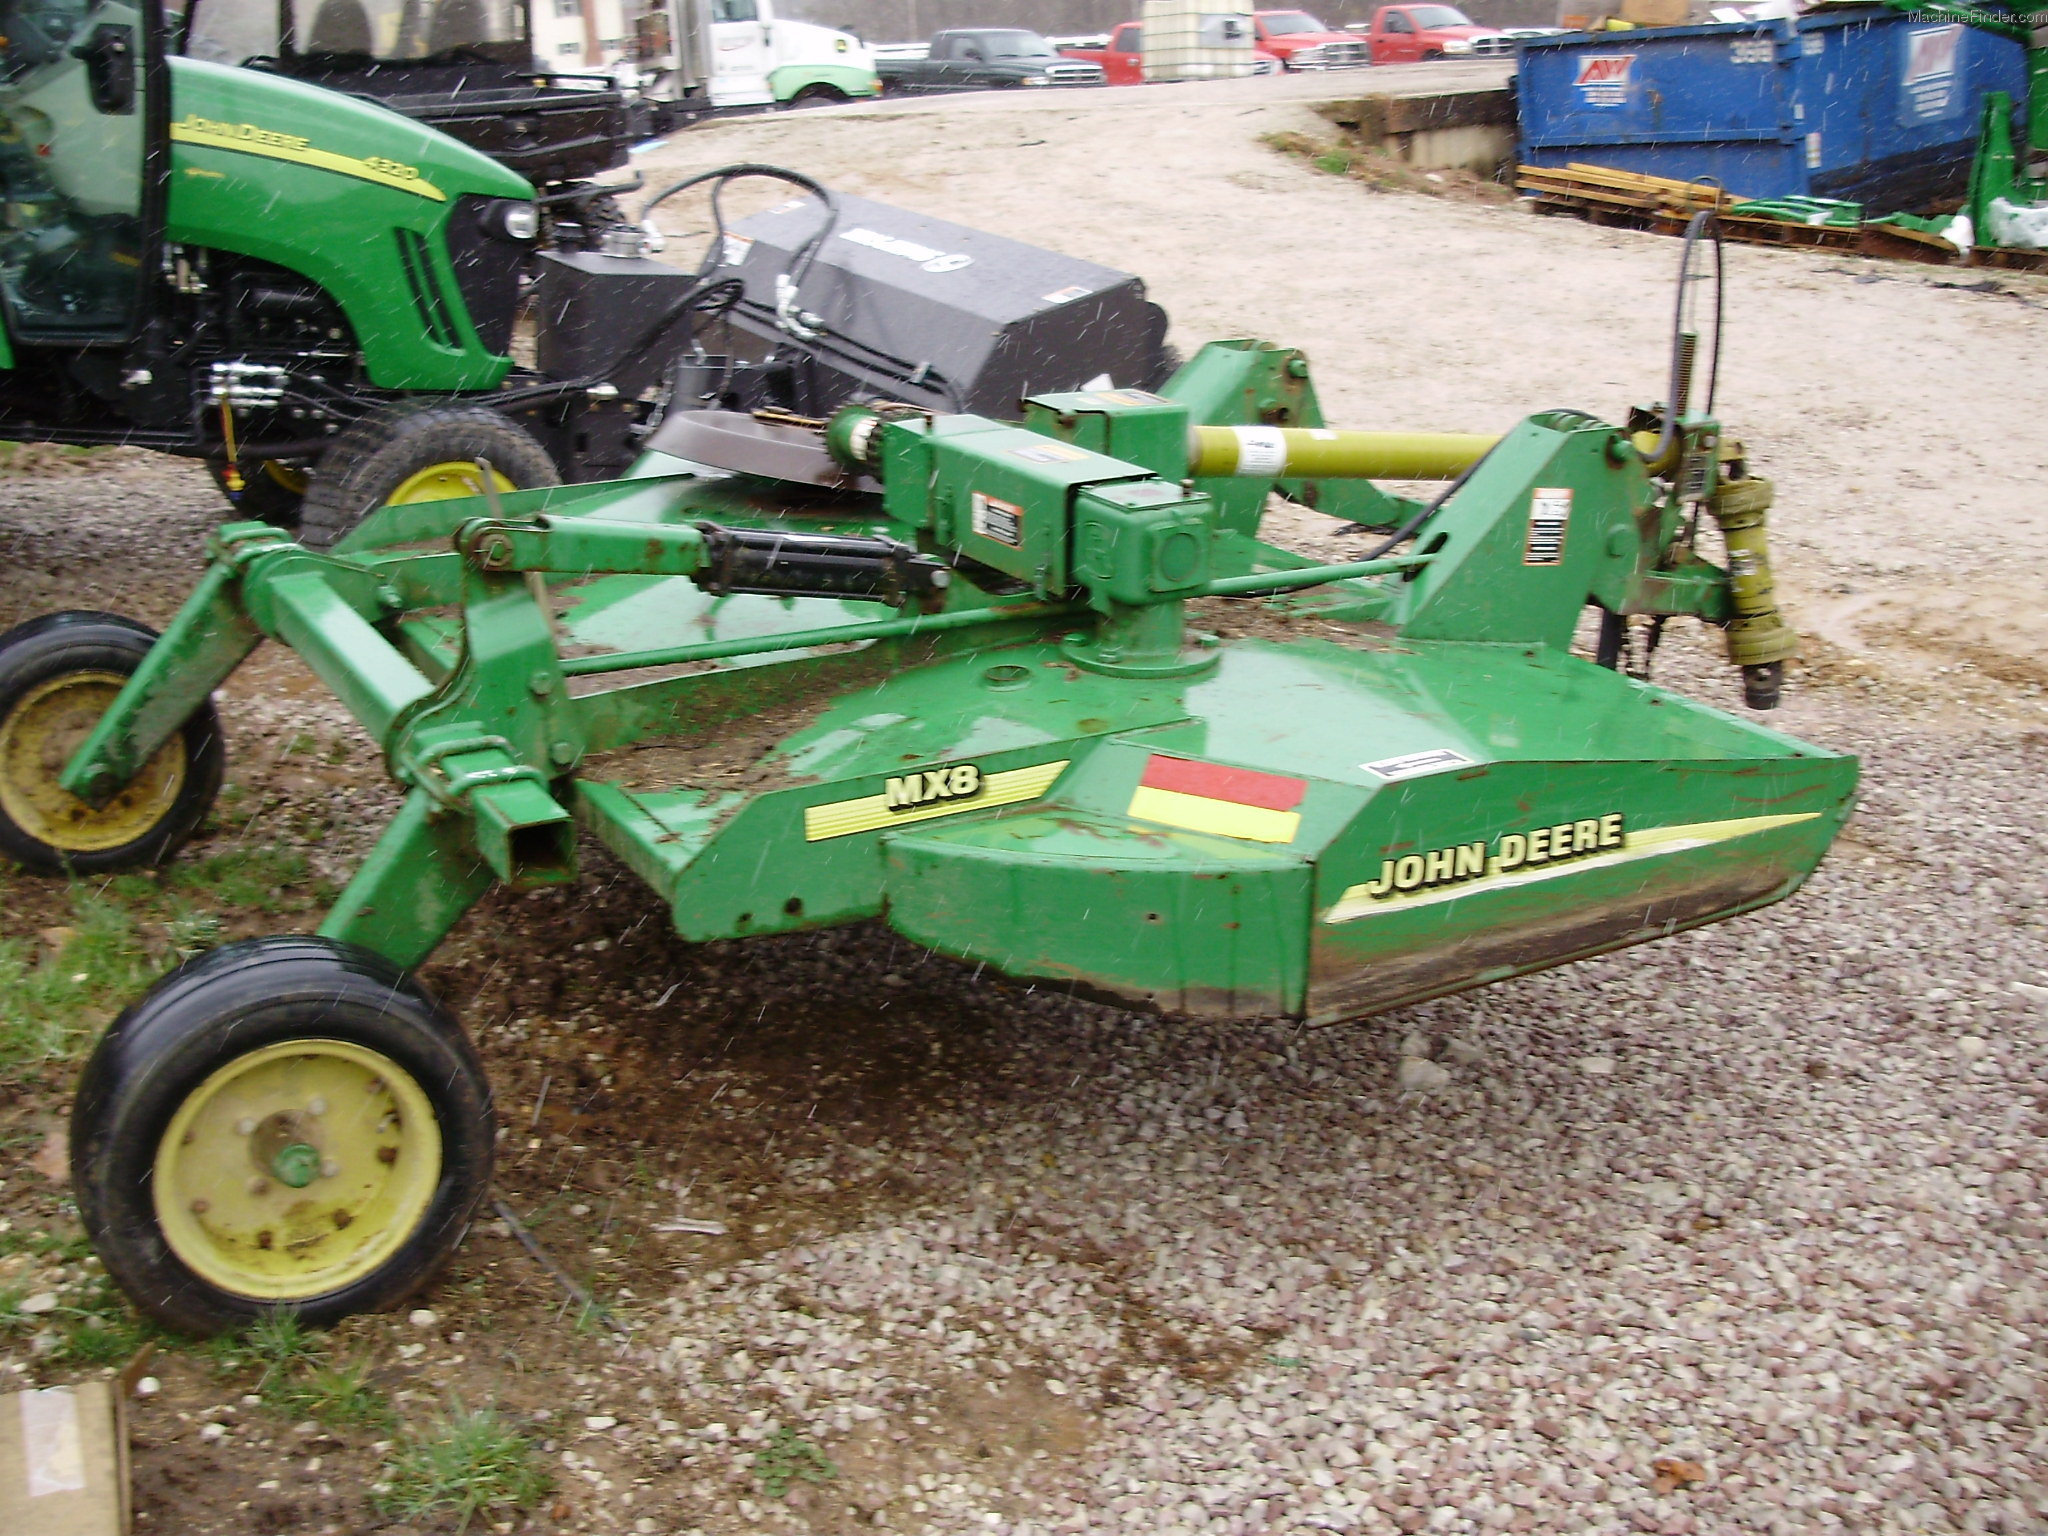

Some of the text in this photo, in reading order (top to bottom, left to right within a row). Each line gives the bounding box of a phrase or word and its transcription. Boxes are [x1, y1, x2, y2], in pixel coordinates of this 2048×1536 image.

[179, 114, 310, 151] JOHN DEERE
[362, 156, 419, 180] 4320
[885, 764, 982, 810] MX8
[1367, 812, 1622, 899] JOHN DEERE
